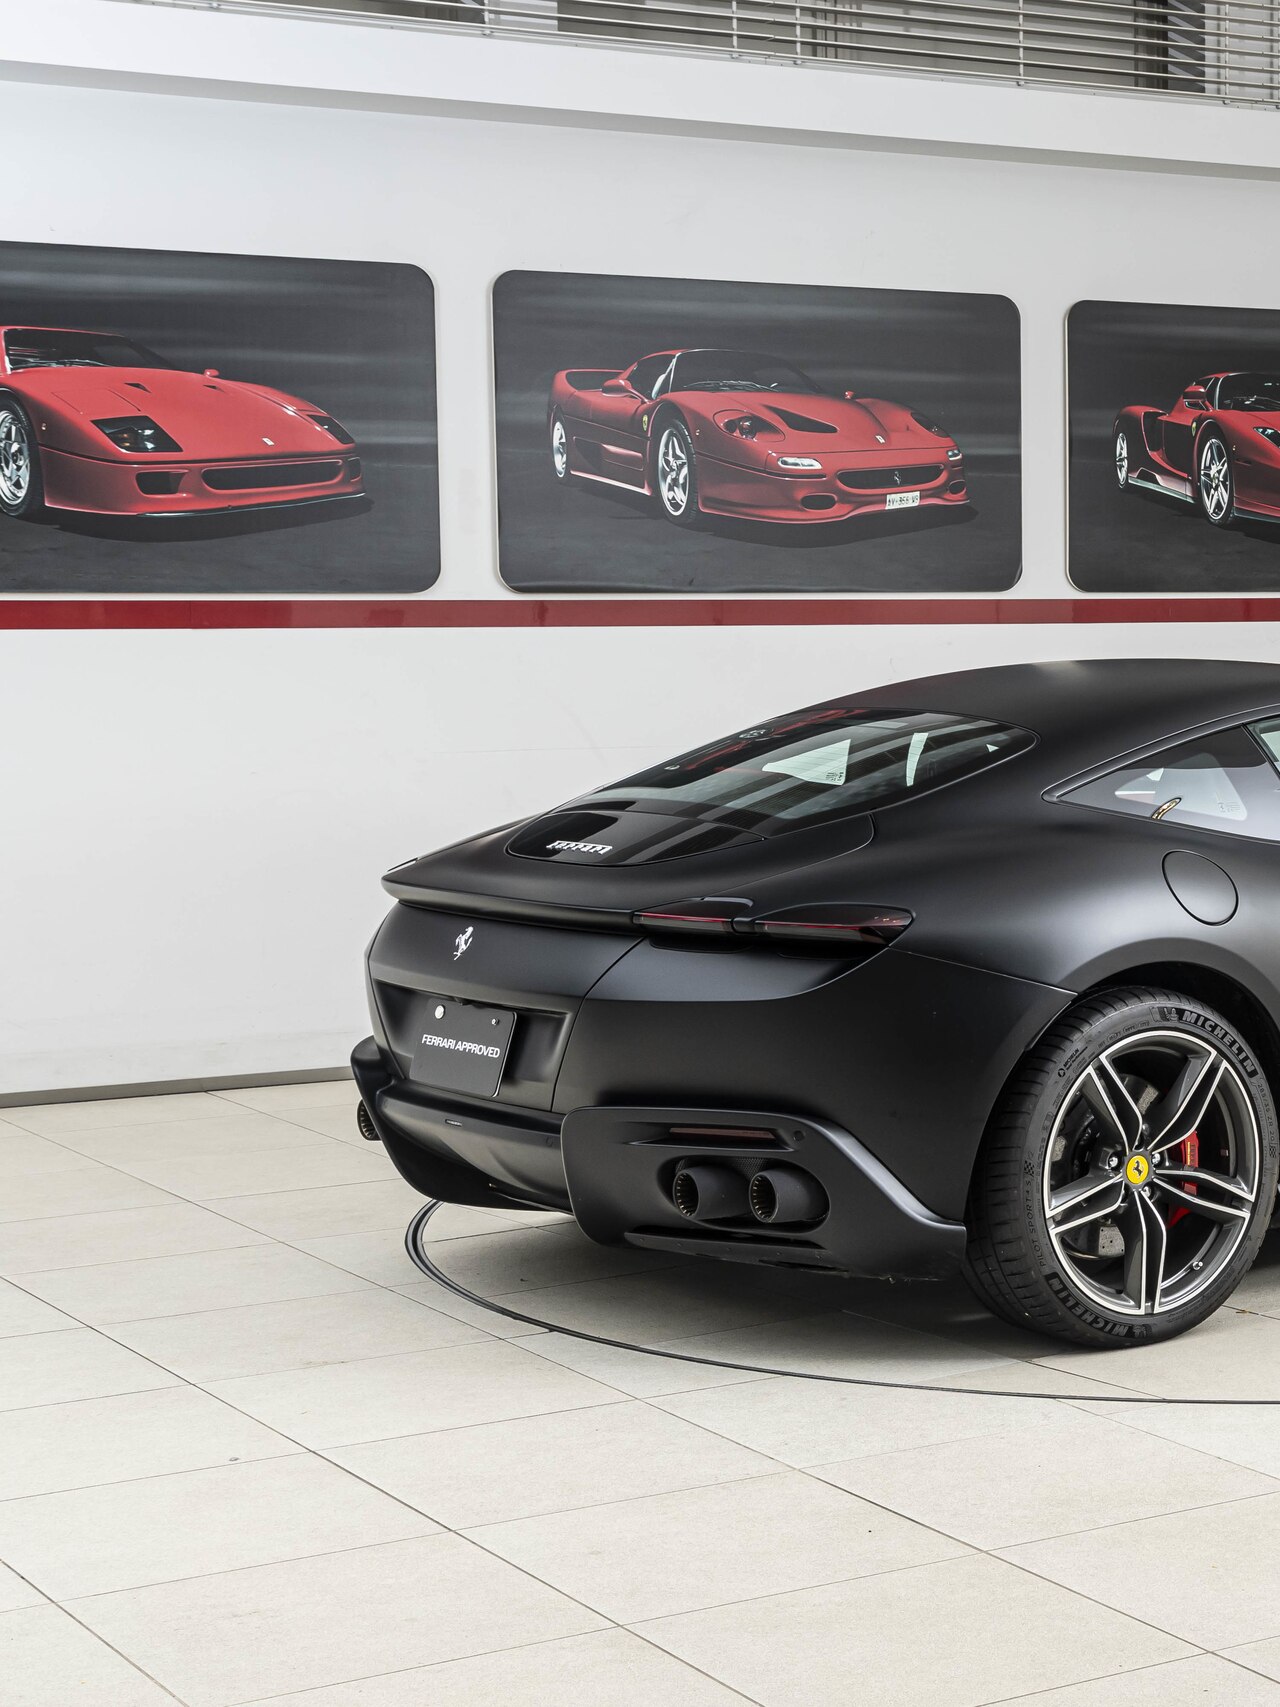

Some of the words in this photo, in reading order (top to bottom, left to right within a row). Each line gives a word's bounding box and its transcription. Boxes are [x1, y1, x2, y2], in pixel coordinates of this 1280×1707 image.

[421, 1034, 456, 1050] FERRARI
[455, 1041, 500, 1058] APPROVED
[1182, 1010, 1255, 1073] MICHELIN
[1025, 1198, 1036, 1233] SPORT
[1031, 1239, 1046, 1267] PILOT
[1048, 1277, 1129, 1337] MICHELIN
